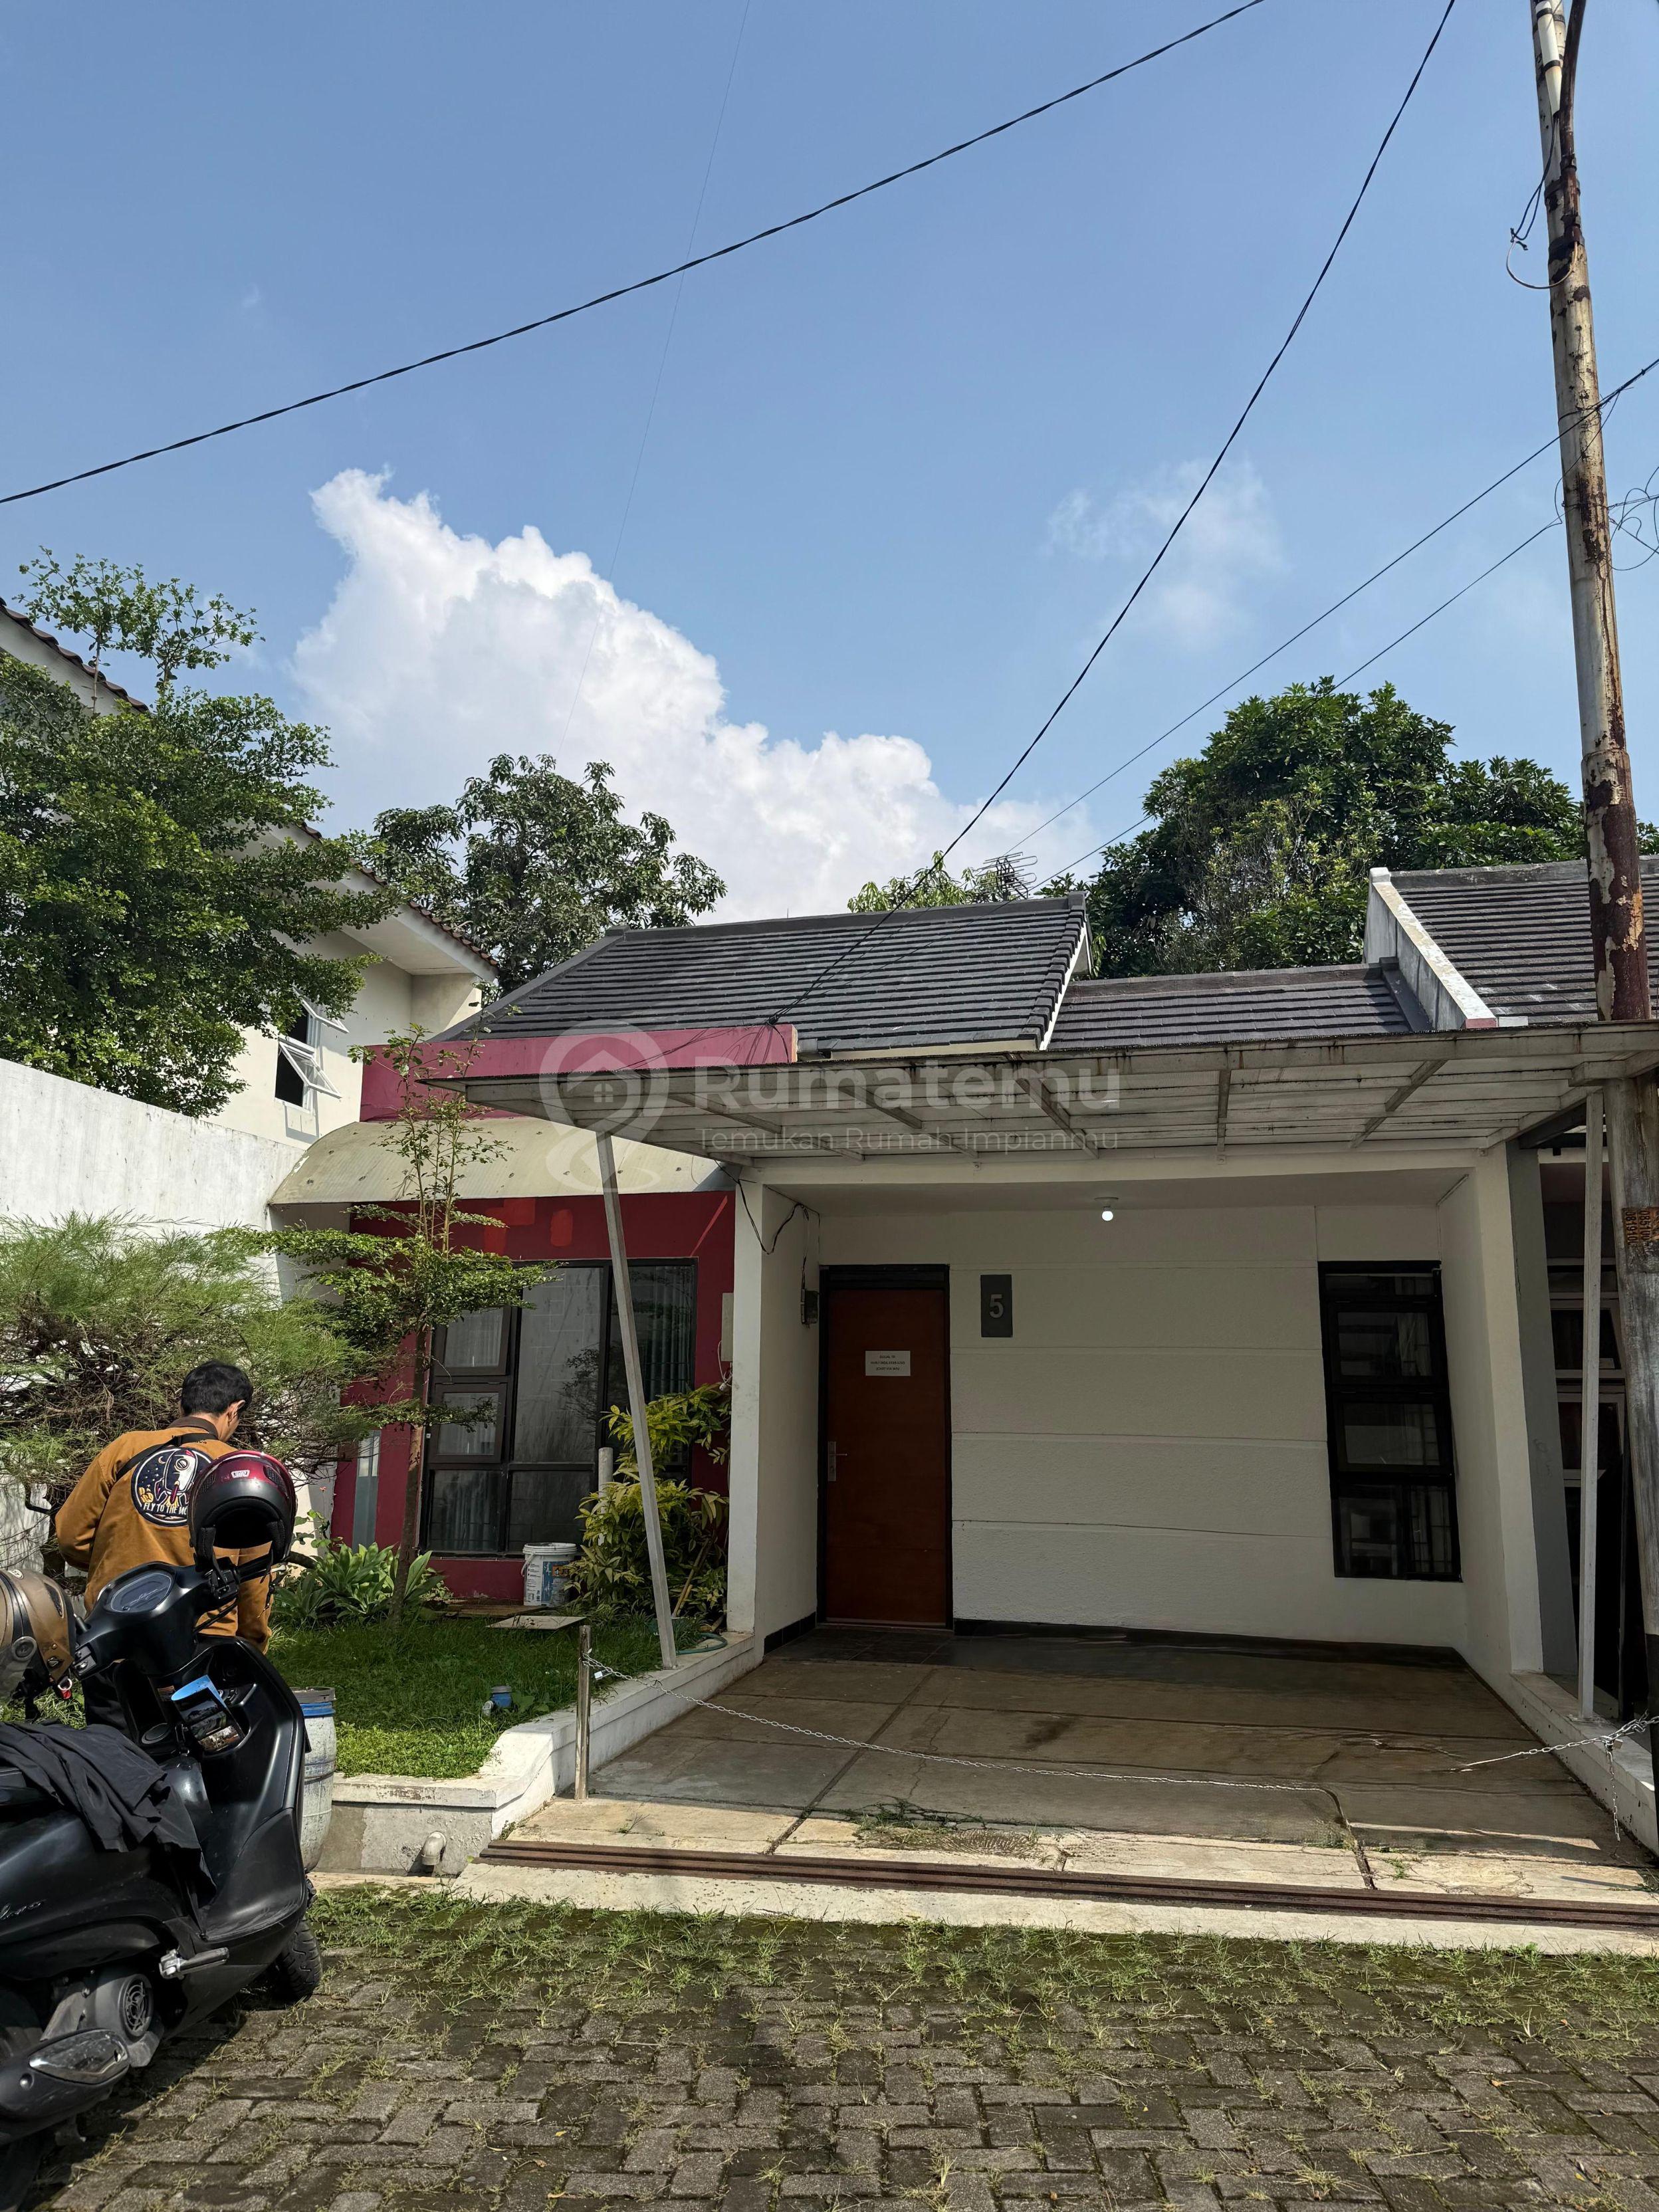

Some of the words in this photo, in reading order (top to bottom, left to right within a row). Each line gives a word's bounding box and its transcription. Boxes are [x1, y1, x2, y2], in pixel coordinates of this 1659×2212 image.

[988, 1293, 1004, 1319] 5
[143, 1502, 156, 1511] FLY
[156, 1503, 165, 1512] TO
[166, 1505, 178, 1513] THE
